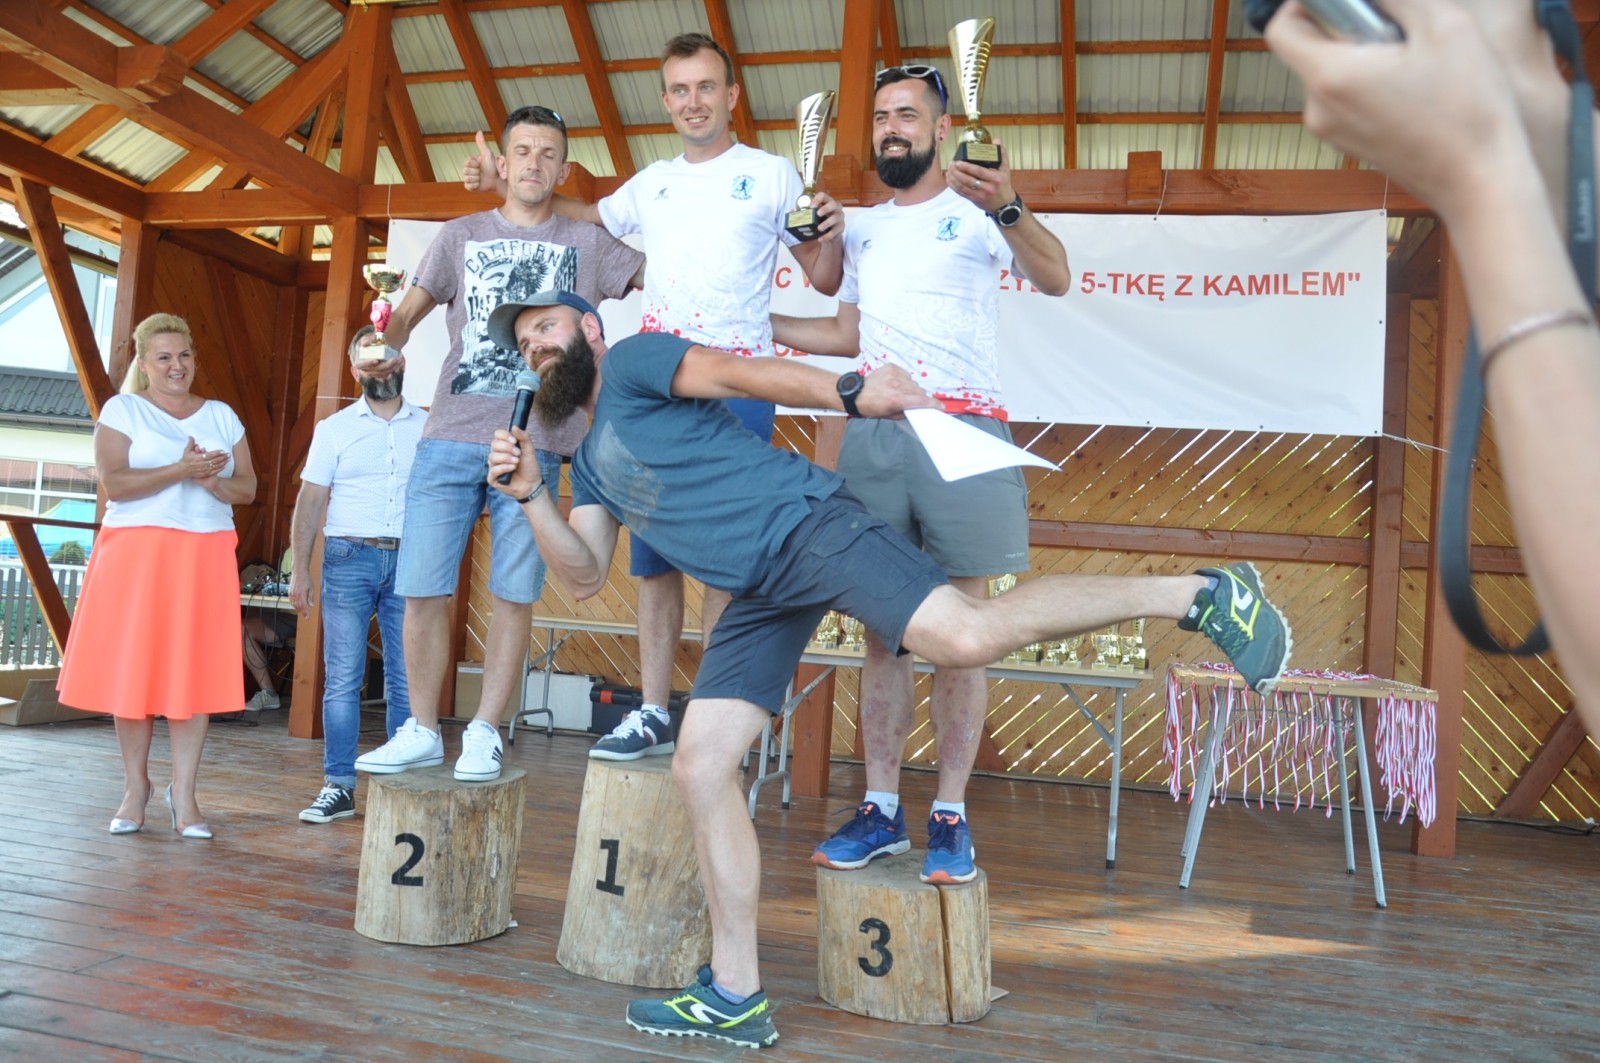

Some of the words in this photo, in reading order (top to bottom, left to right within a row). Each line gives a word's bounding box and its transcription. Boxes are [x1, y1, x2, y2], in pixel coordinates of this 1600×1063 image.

[1080, 271, 1166, 301] 5-TKĘ
[1174, 275, 1193, 296] Z
[1203, 271, 1361, 297] KAMILEM"
[391, 832, 425, 887] 2
[595, 838, 625, 897] 1
[858, 917, 894, 977] 3
